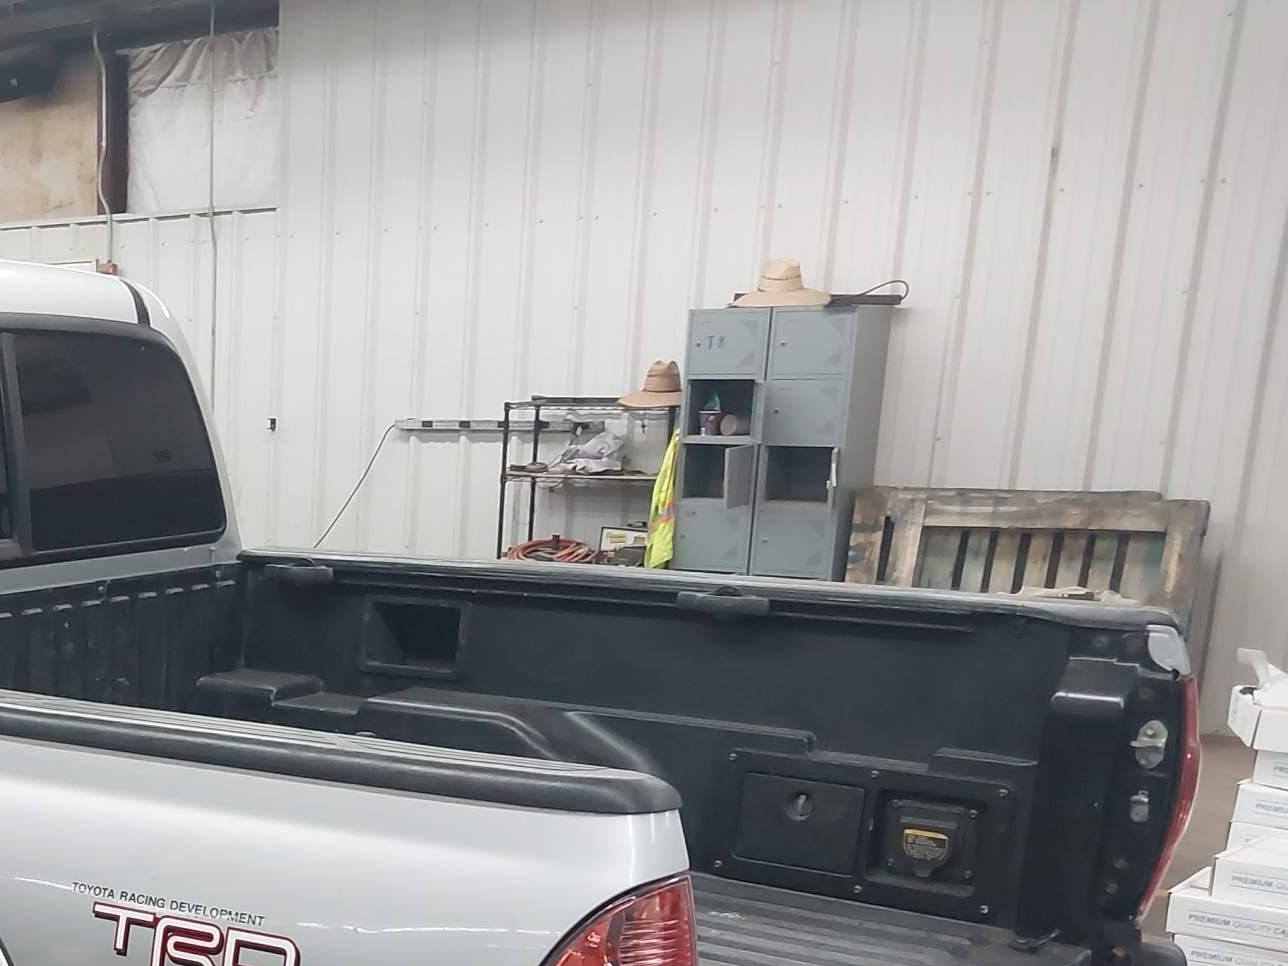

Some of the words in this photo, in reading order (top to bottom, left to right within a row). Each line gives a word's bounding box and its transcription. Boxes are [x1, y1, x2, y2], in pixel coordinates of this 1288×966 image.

[72, 882, 115, 899] TOYOTA
[119, 890, 166, 909] RACING
[170, 900, 265, 927] DEVELOPMENT
[1188, 913, 1231, 926] PREMIUM
